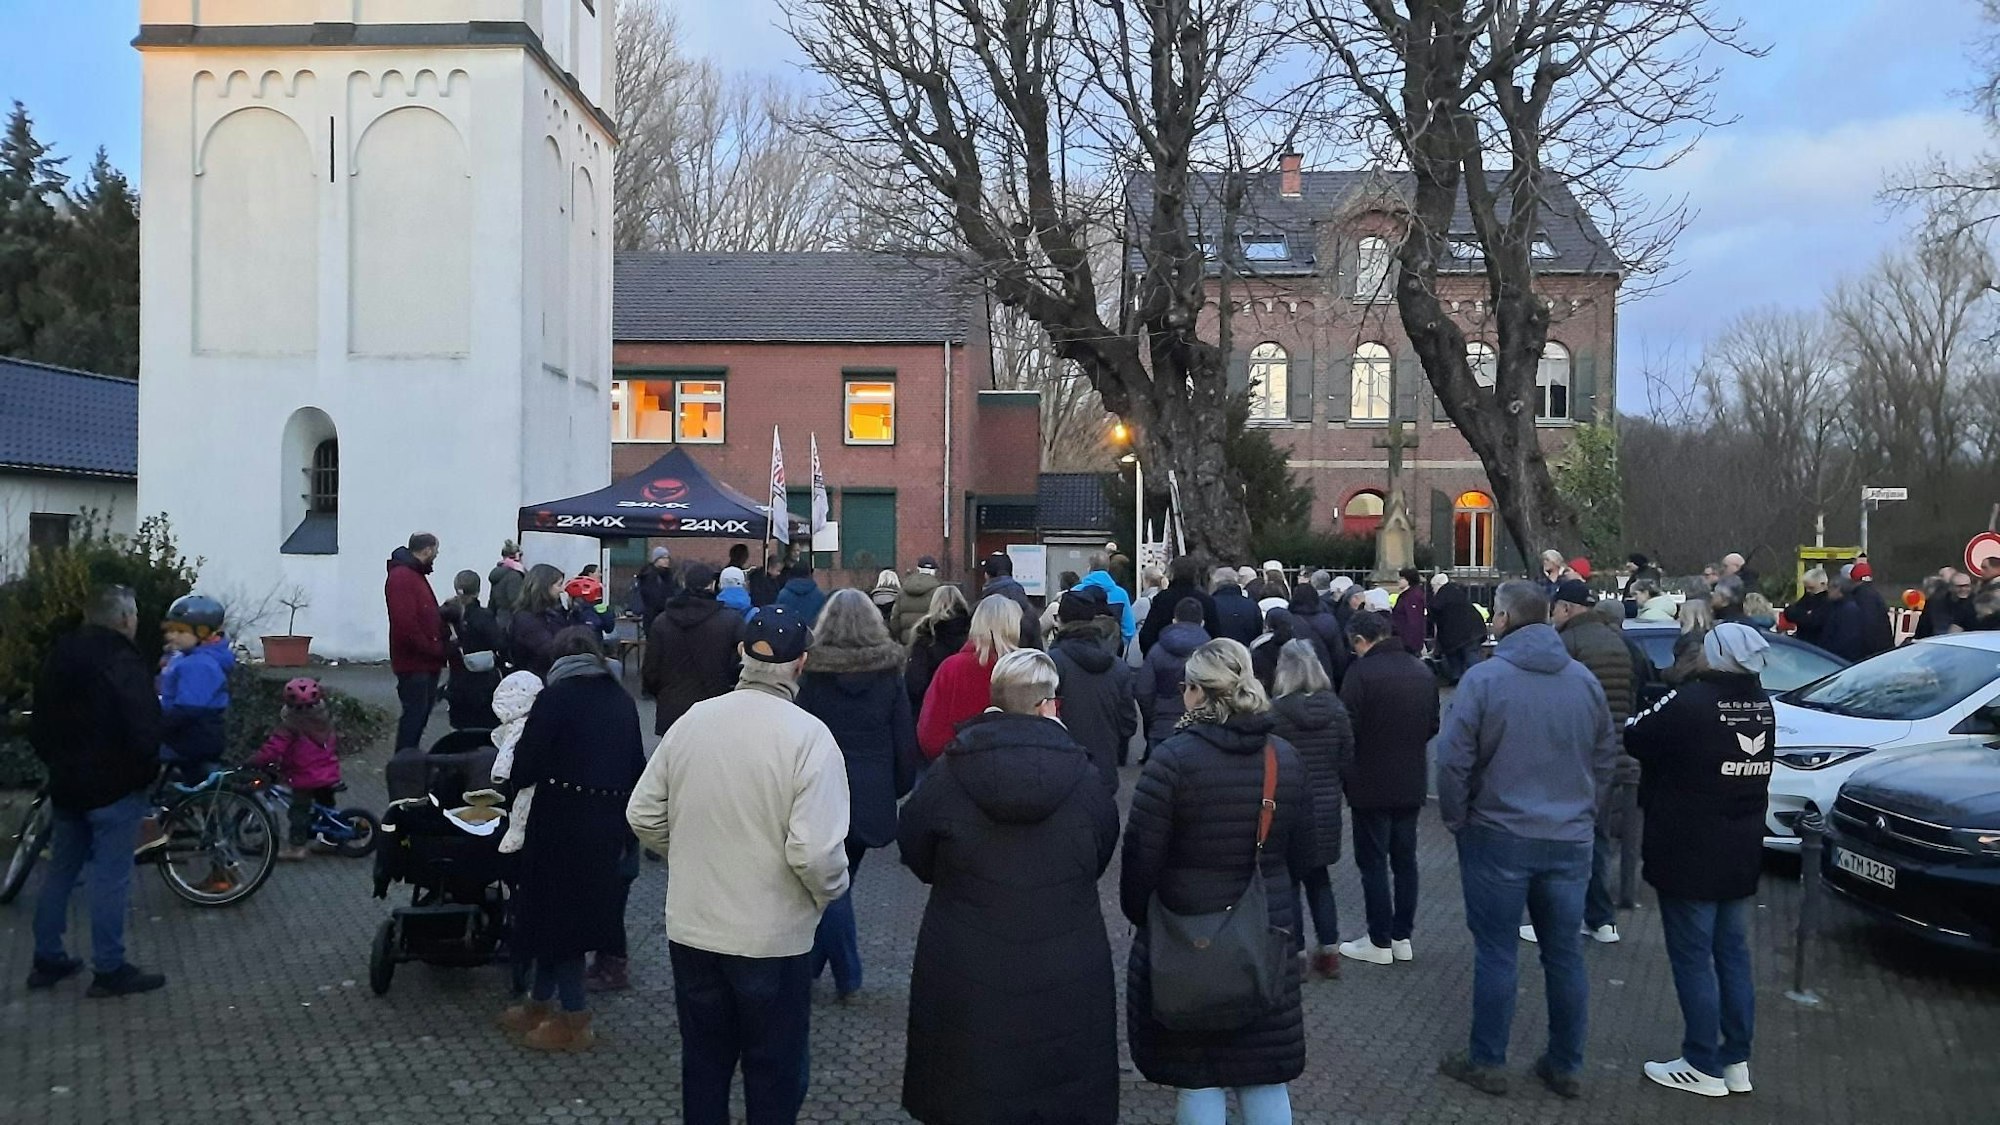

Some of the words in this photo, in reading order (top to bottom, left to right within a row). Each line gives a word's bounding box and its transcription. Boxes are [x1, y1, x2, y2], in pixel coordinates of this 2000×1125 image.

[616, 500, 690, 509] 24MX
[557, 514, 626, 528] 24MX
[680, 518, 750, 533] 24MX
[1721, 759, 1771, 776] erima
[1837, 850, 1845, 866] K
[1851, 855, 1865, 873] TM
[1867, 862, 1894, 885] 1213
